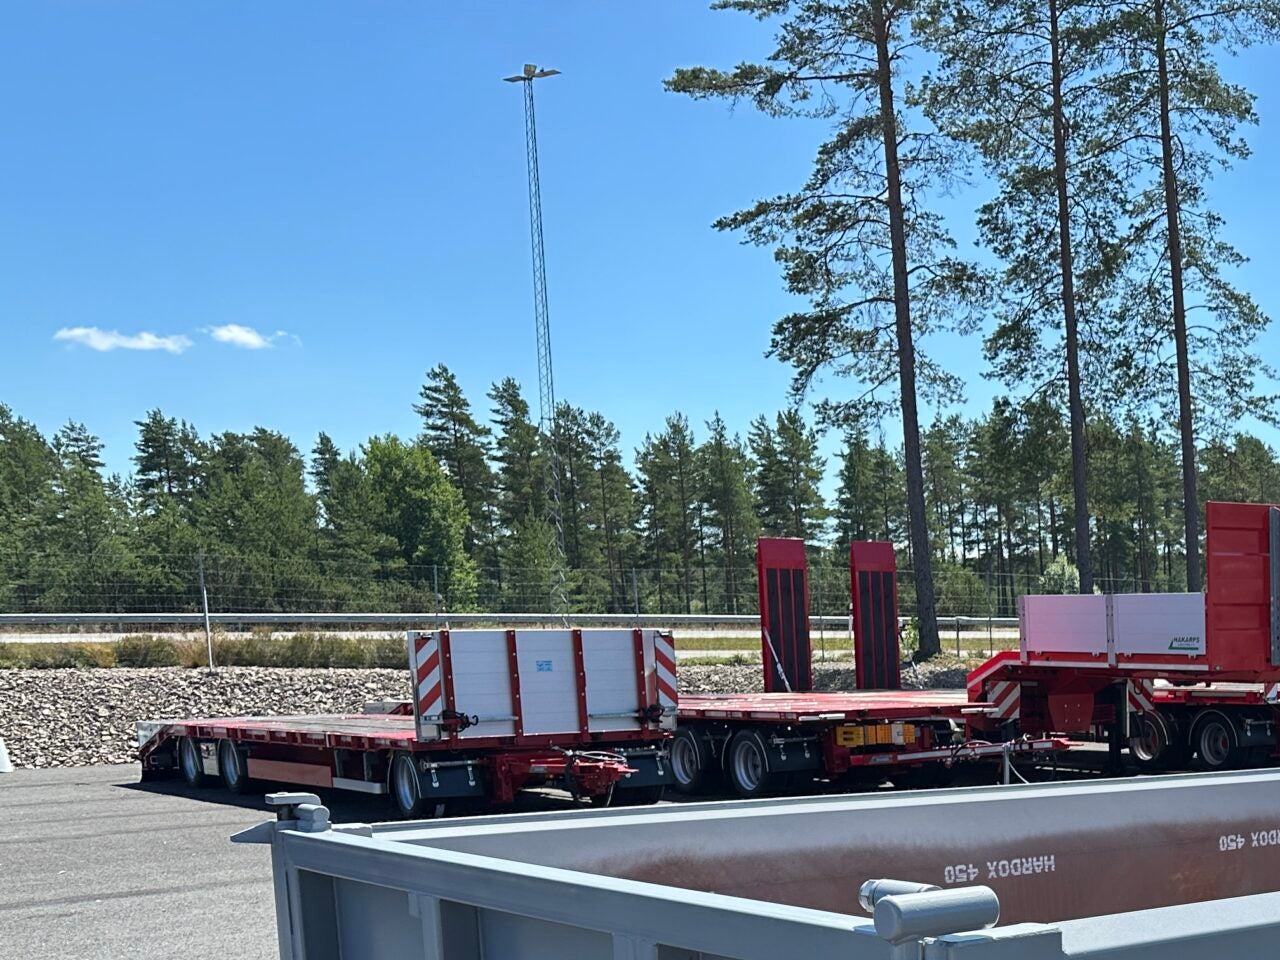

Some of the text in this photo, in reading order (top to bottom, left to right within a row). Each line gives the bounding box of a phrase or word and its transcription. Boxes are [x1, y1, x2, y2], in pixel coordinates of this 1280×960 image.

[1219, 833, 1245, 851] 450
[944, 854, 1055, 884] HARDOX 450
